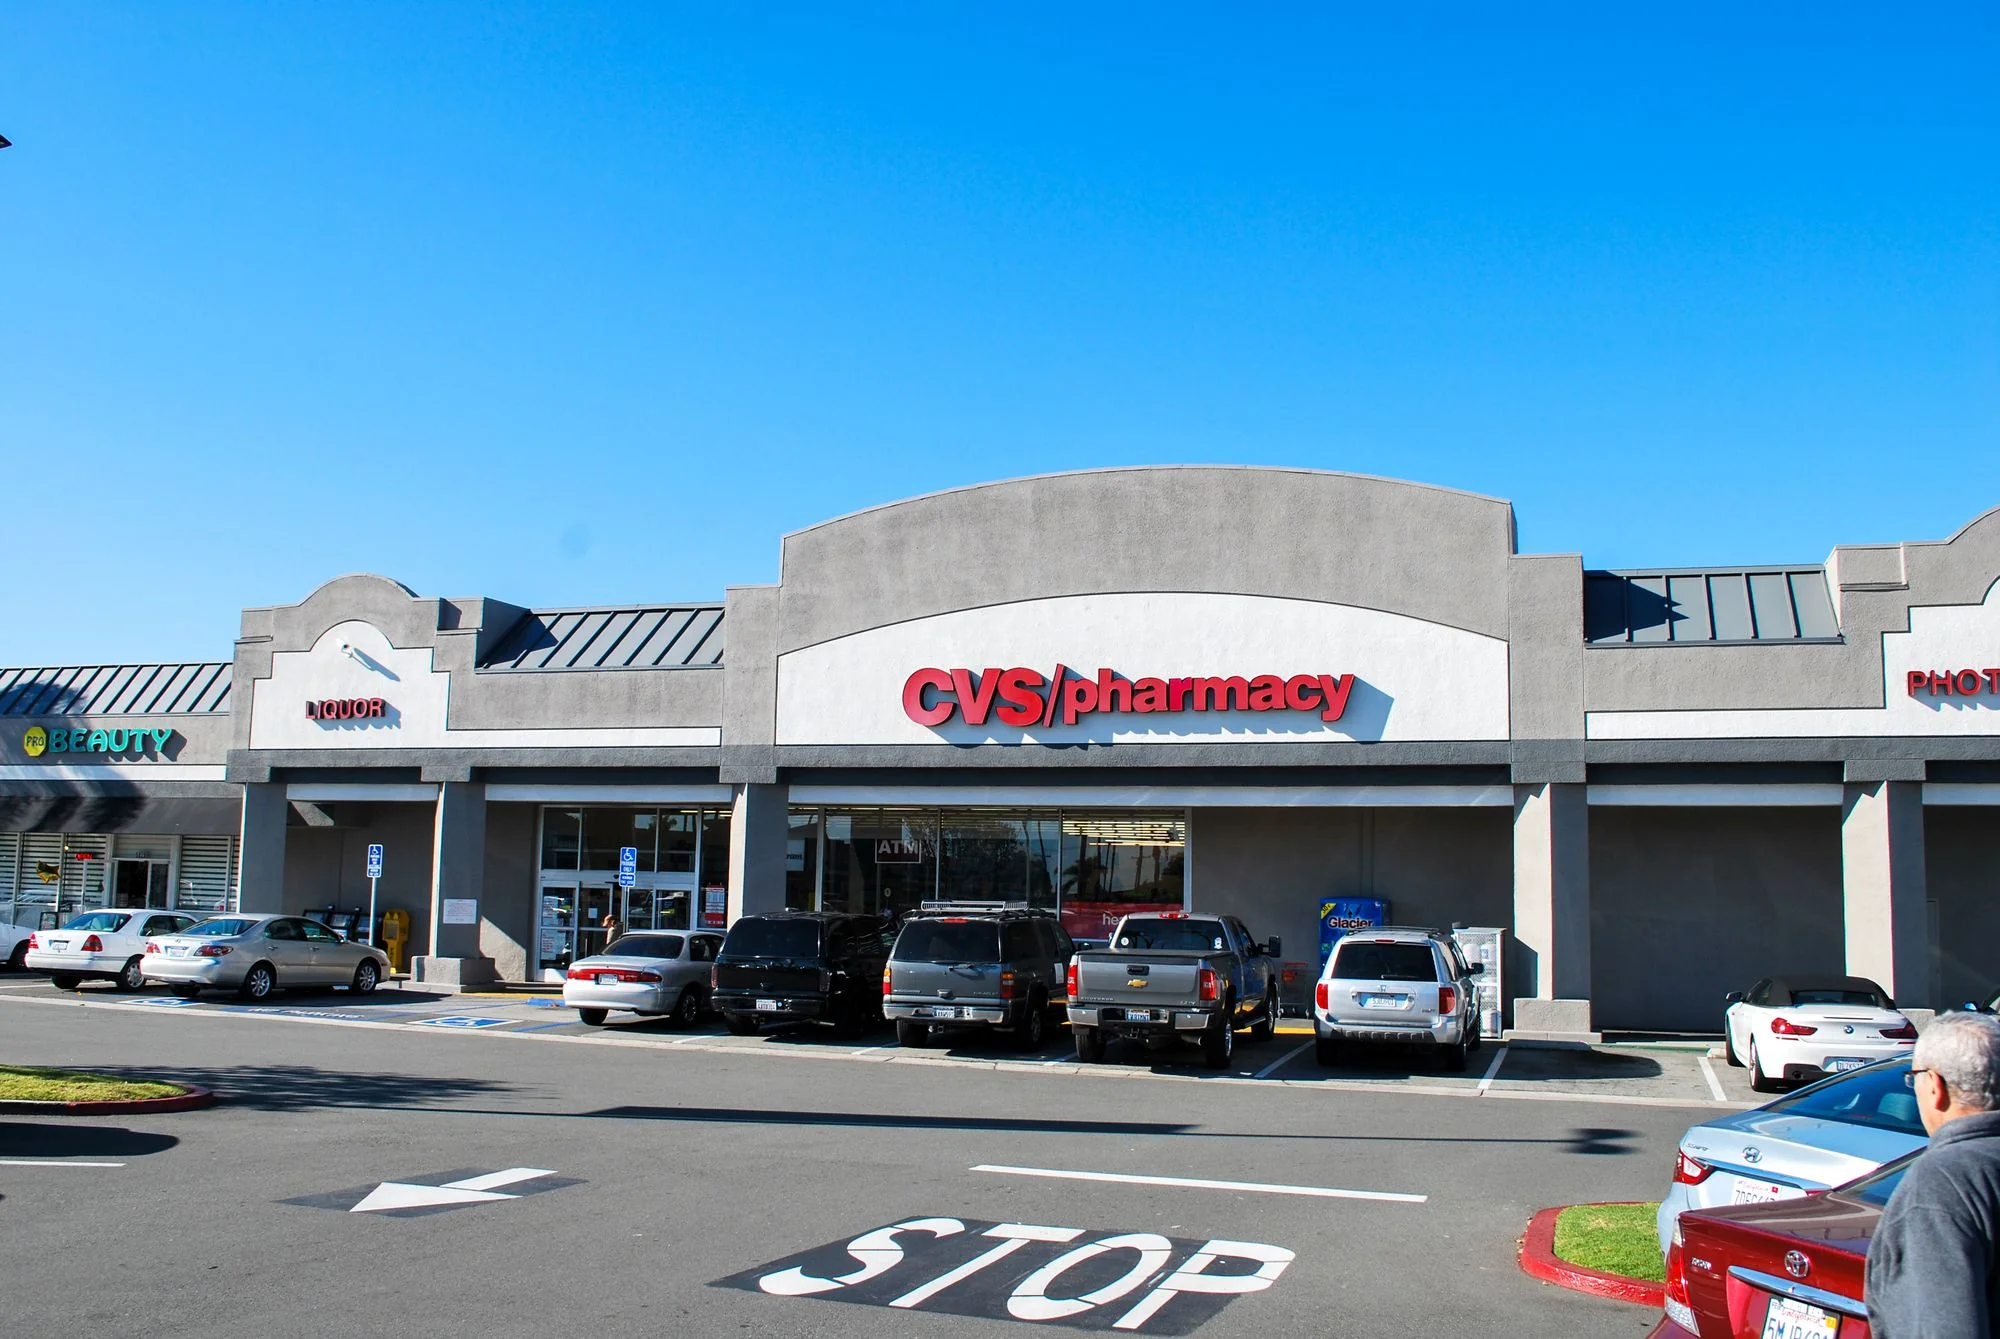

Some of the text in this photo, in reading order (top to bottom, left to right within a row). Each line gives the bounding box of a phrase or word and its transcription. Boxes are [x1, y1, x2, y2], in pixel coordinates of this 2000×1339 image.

[902, 663, 1354, 727] CVS/pharmacy
[305, 698, 386, 719] LIQUOR
[26, 728, 173, 753] PRO BEAUTY
[878, 839, 918, 854] ATM
[1328, 916, 1374, 929] Glacier
[759, 1218, 1296, 1329] STOP
